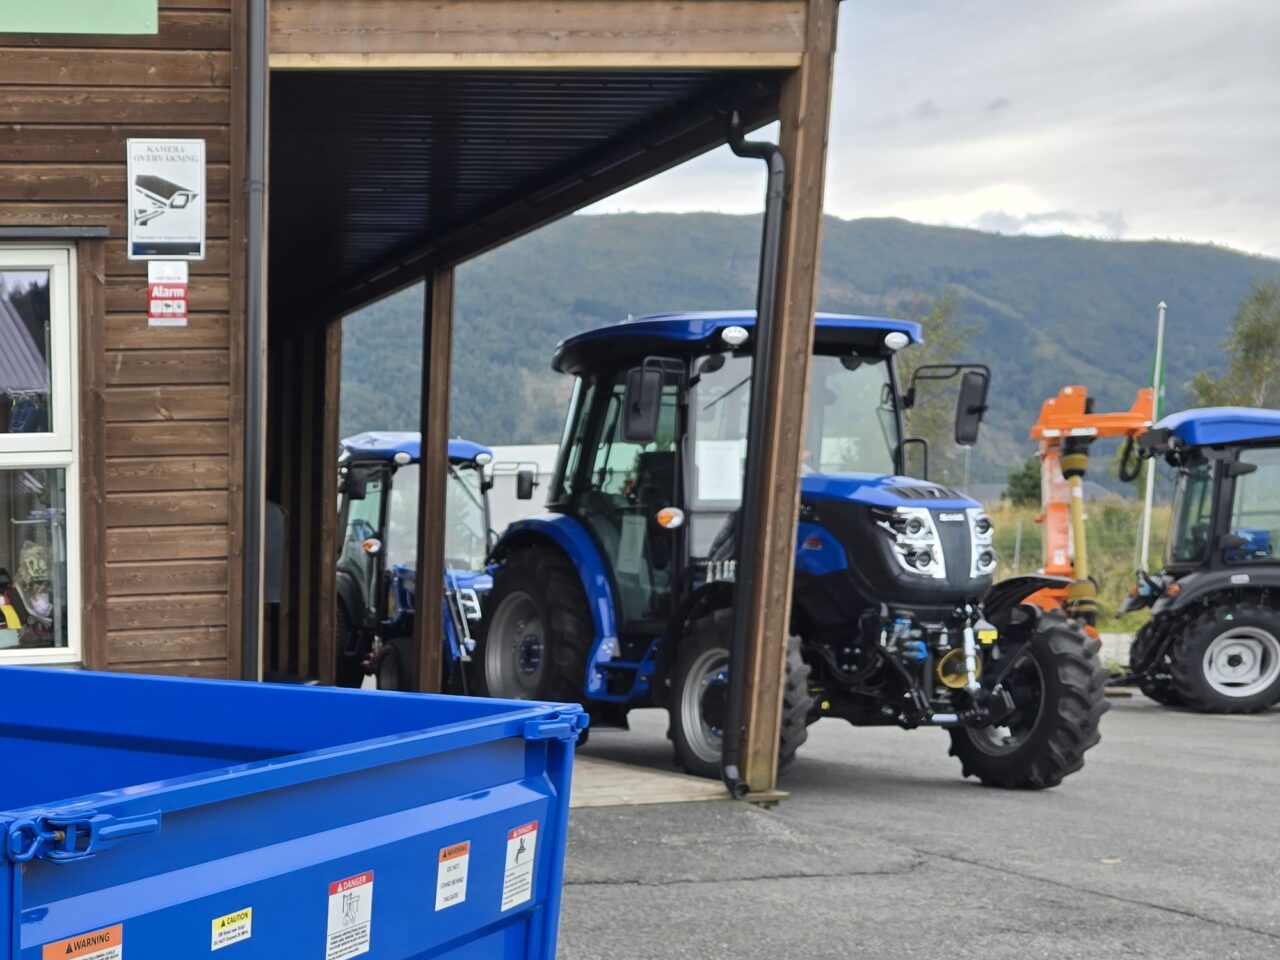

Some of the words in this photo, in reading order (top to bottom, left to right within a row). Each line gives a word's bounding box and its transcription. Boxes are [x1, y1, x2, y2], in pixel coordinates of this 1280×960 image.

[152, 285, 185, 298] Alarm
[343, 875, 367, 890] DANGER
[226, 912, 248, 925] CAUTION
[74, 932, 110, 951] WARNING
